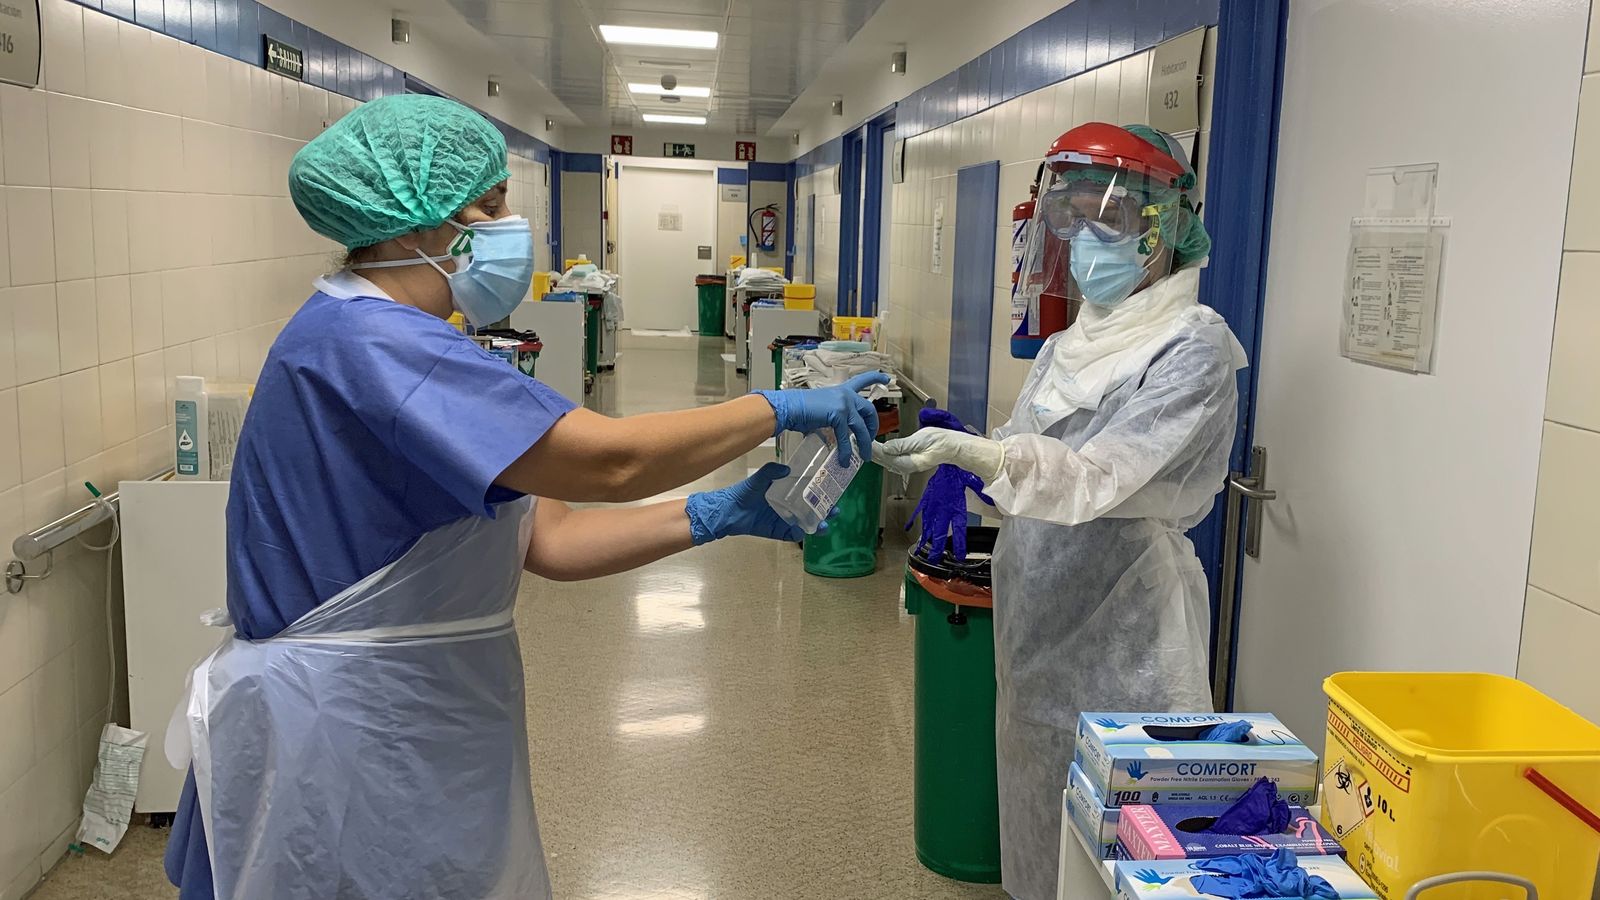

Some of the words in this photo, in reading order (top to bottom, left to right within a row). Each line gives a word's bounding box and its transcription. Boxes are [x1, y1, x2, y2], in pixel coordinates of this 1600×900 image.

[1164, 90, 1179, 110] 432
[1141, 715, 1223, 723] COMFORT
[1352, 736, 1373, 760] PELIGRO
[1177, 762, 1257, 776] COMFORT
[1114, 791, 1141, 806] 100
[1377, 794, 1388, 814] 10
[1336, 824, 1343, 835] 6
